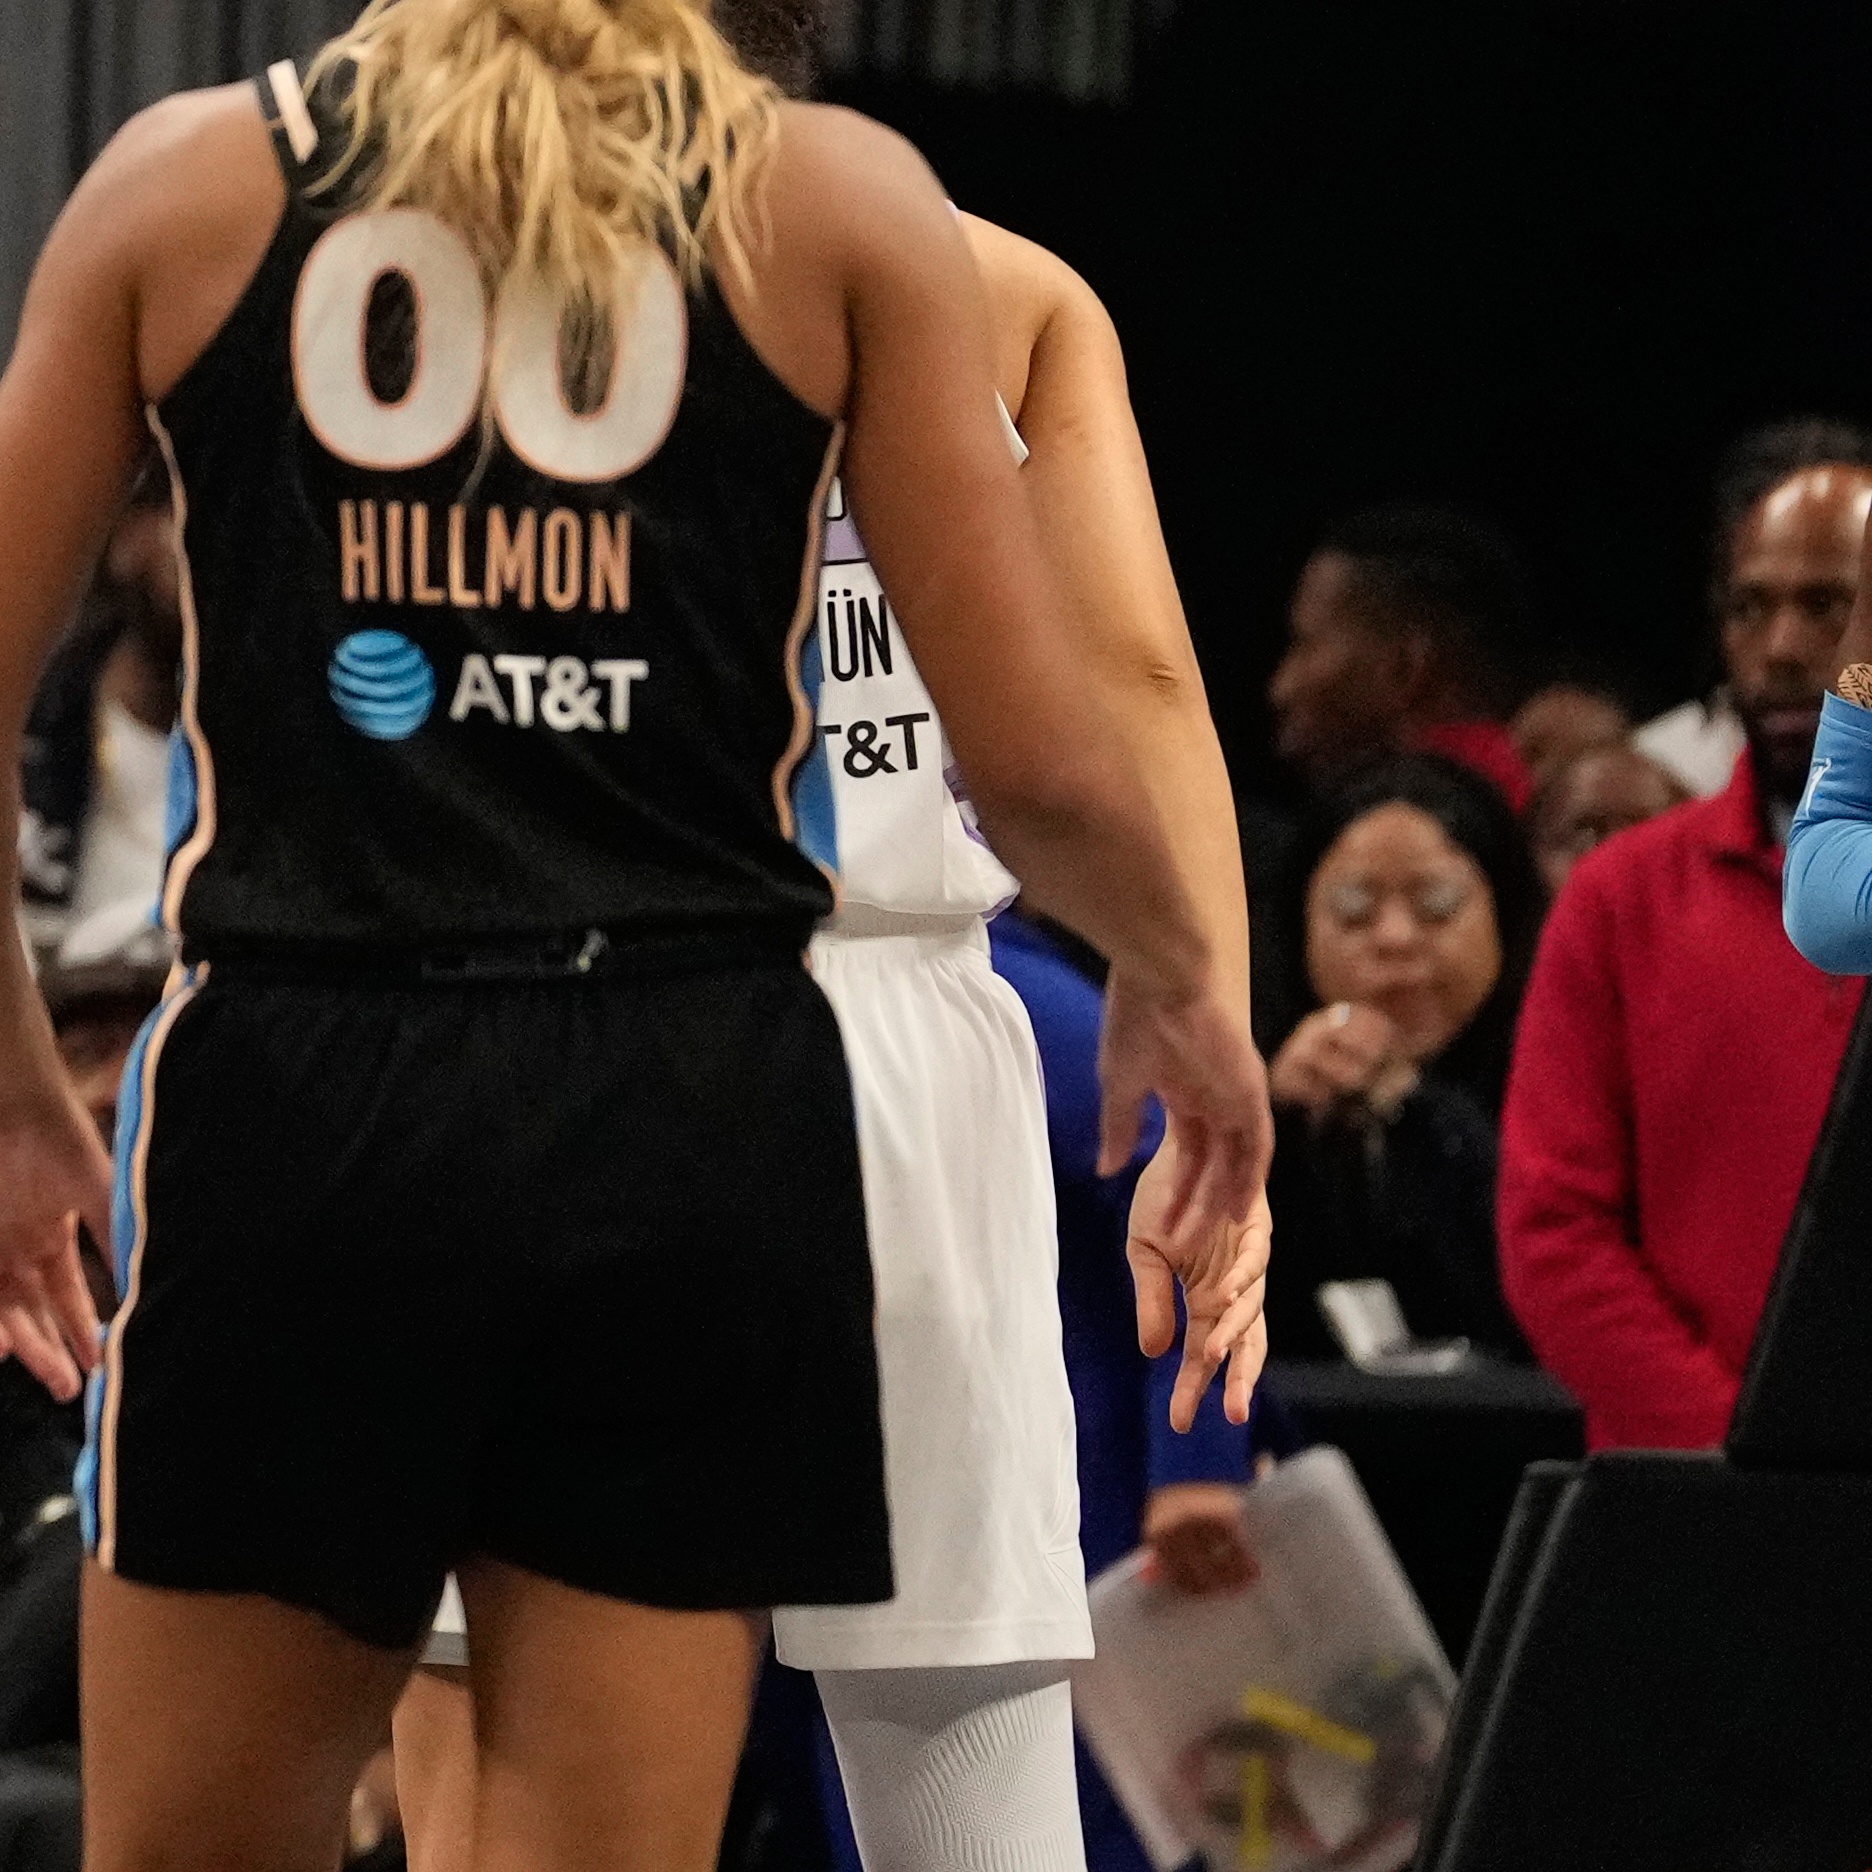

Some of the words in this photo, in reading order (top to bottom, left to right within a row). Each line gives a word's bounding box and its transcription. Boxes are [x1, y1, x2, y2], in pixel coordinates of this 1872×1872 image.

[290, 207, 689, 484] 00
[337, 500, 632, 613] HILLMON
[449, 654, 649, 732] AT&T
